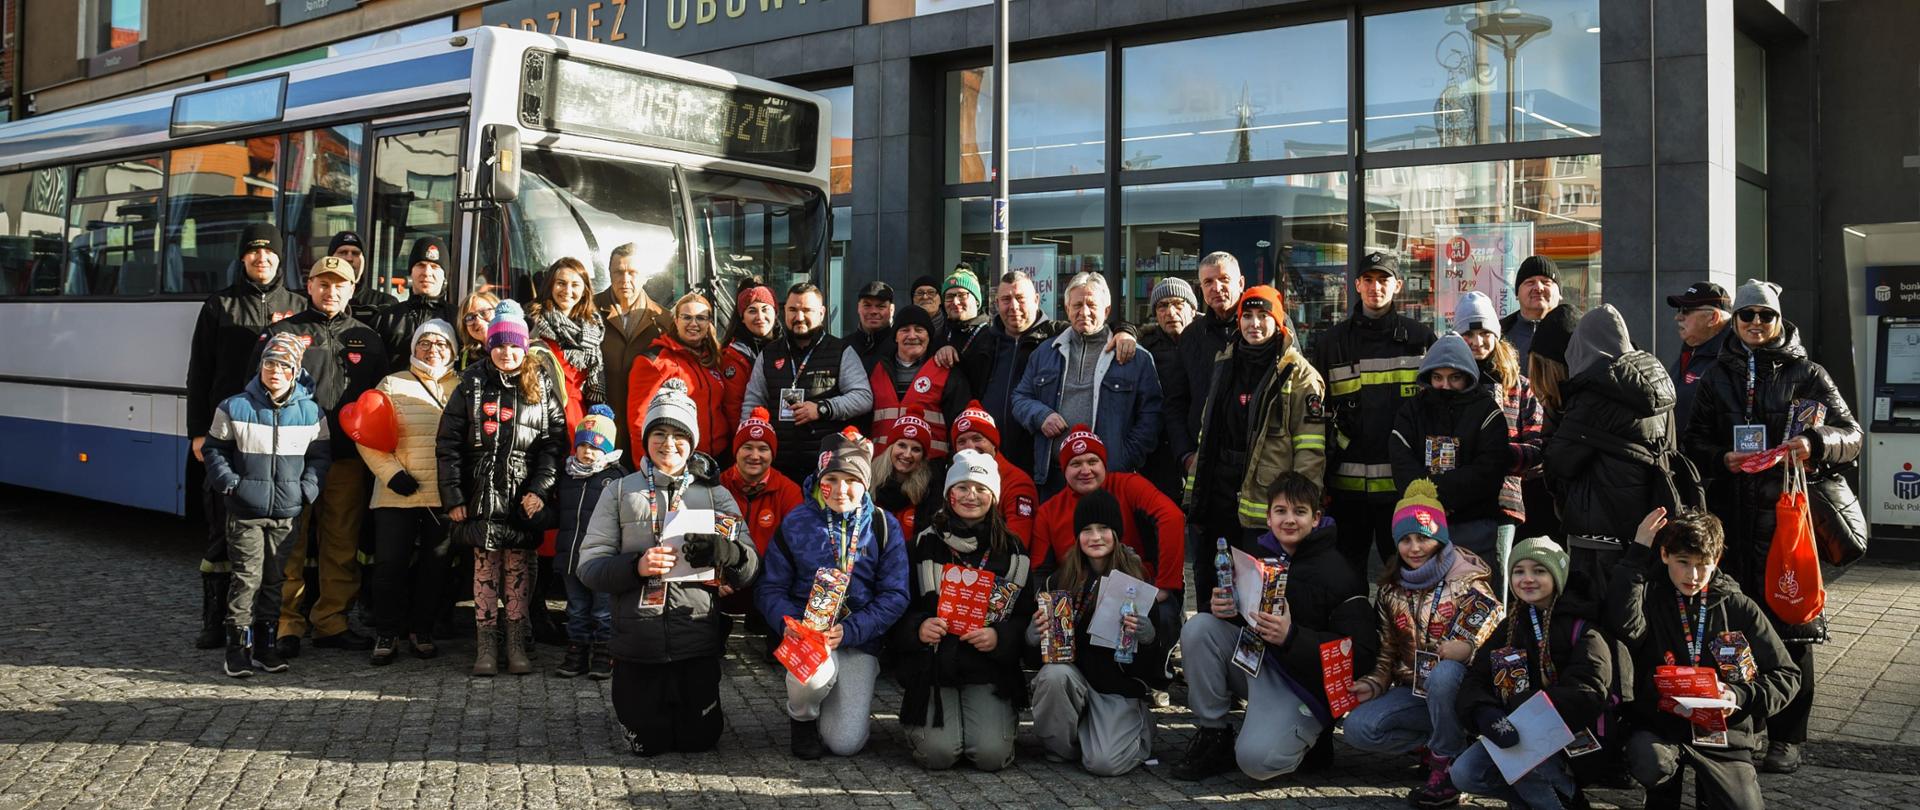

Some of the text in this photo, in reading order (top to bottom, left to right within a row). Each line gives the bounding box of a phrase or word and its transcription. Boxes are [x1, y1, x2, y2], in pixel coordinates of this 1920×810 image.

[703, 97, 769, 144] 2024
[1884, 501, 1905, 510] Bank
[811, 596, 832, 610] 32
